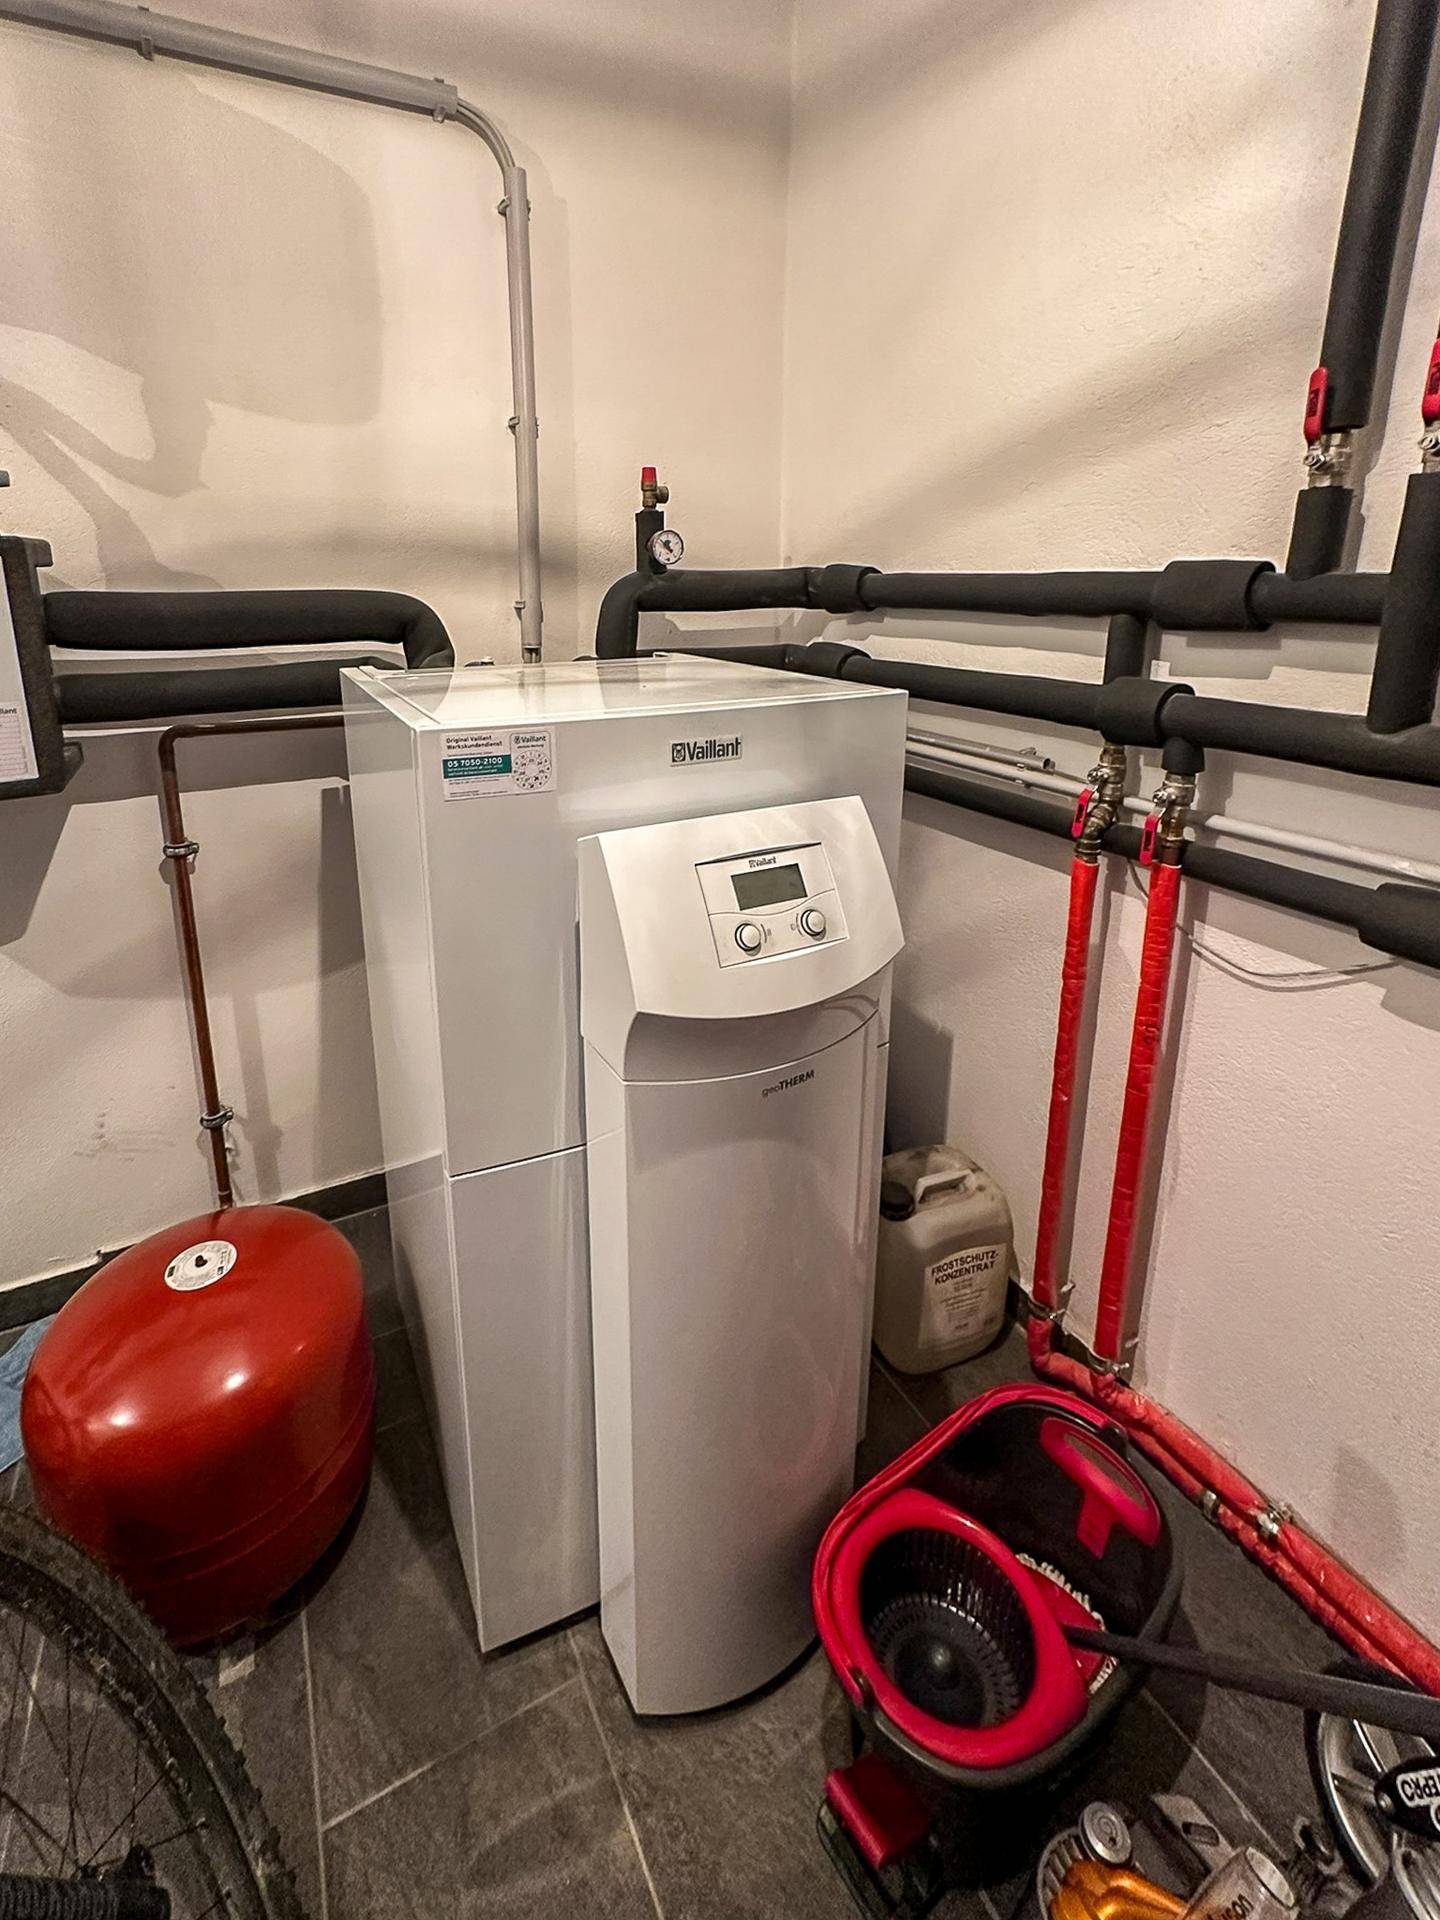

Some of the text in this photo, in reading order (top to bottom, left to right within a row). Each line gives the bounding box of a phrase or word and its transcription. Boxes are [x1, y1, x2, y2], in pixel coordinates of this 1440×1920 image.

[447, 737, 469, 745] Original
[447, 740, 502, 750] Werkskundendienst
[520, 735, 546, 743] Vaillant
[686, 736, 742, 761] Vaillant
[448, 760, 459, 768] 05
[461, 757, 503, 767] 7050-2100
[762, 1069, 815, 1098] geoTHERM
[931, 1250, 999, 1277] FROSTSCHUTZ-
[934, 1261, 995, 1286] KONZENTRAT
